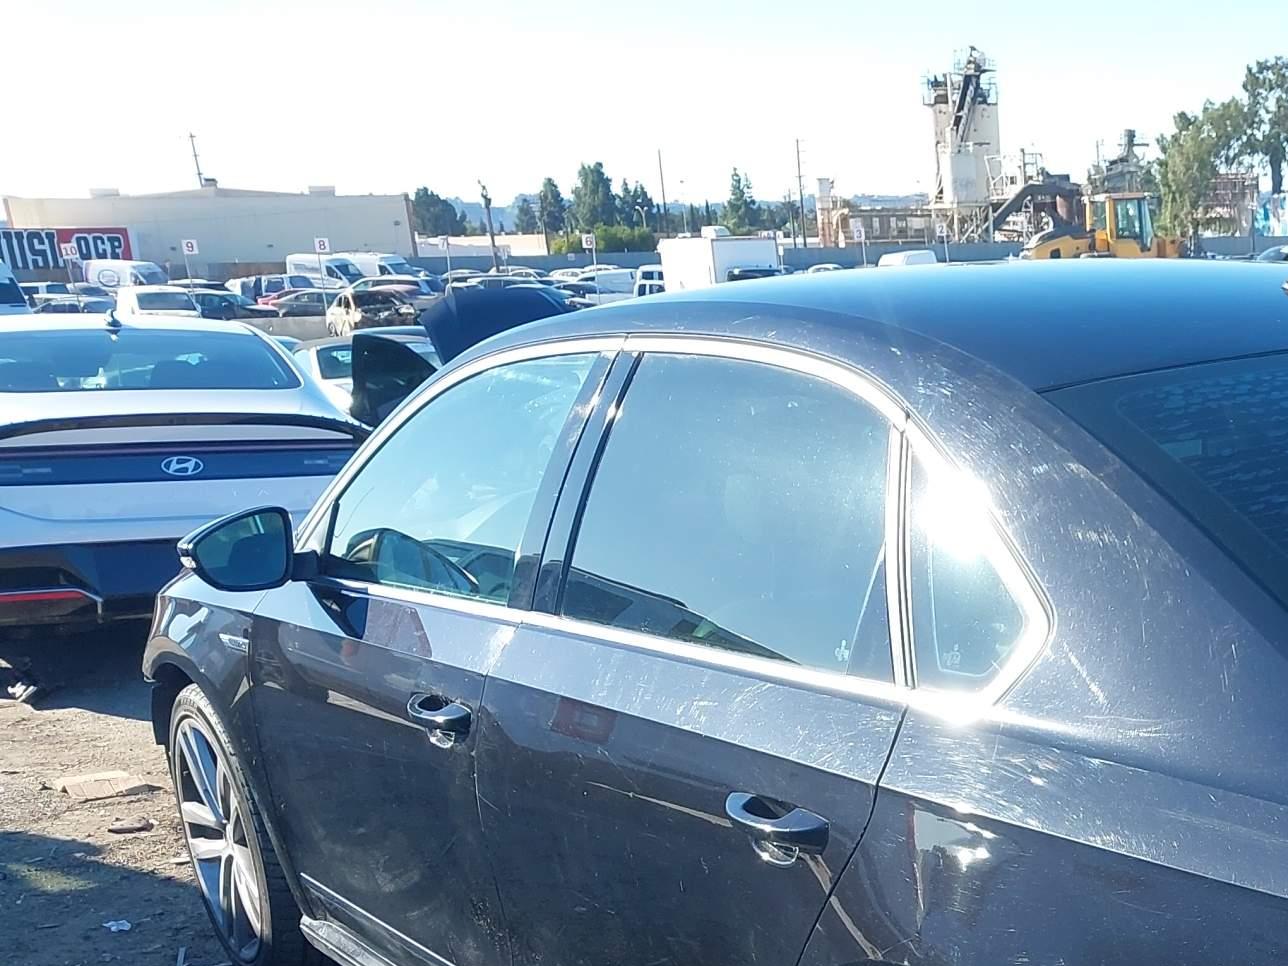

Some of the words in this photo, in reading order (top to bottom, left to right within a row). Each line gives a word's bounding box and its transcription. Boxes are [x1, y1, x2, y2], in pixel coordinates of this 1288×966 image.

[185, 241, 194, 252] 9
[318, 240, 327, 251] 8
[62, 246, 78, 257] 10
